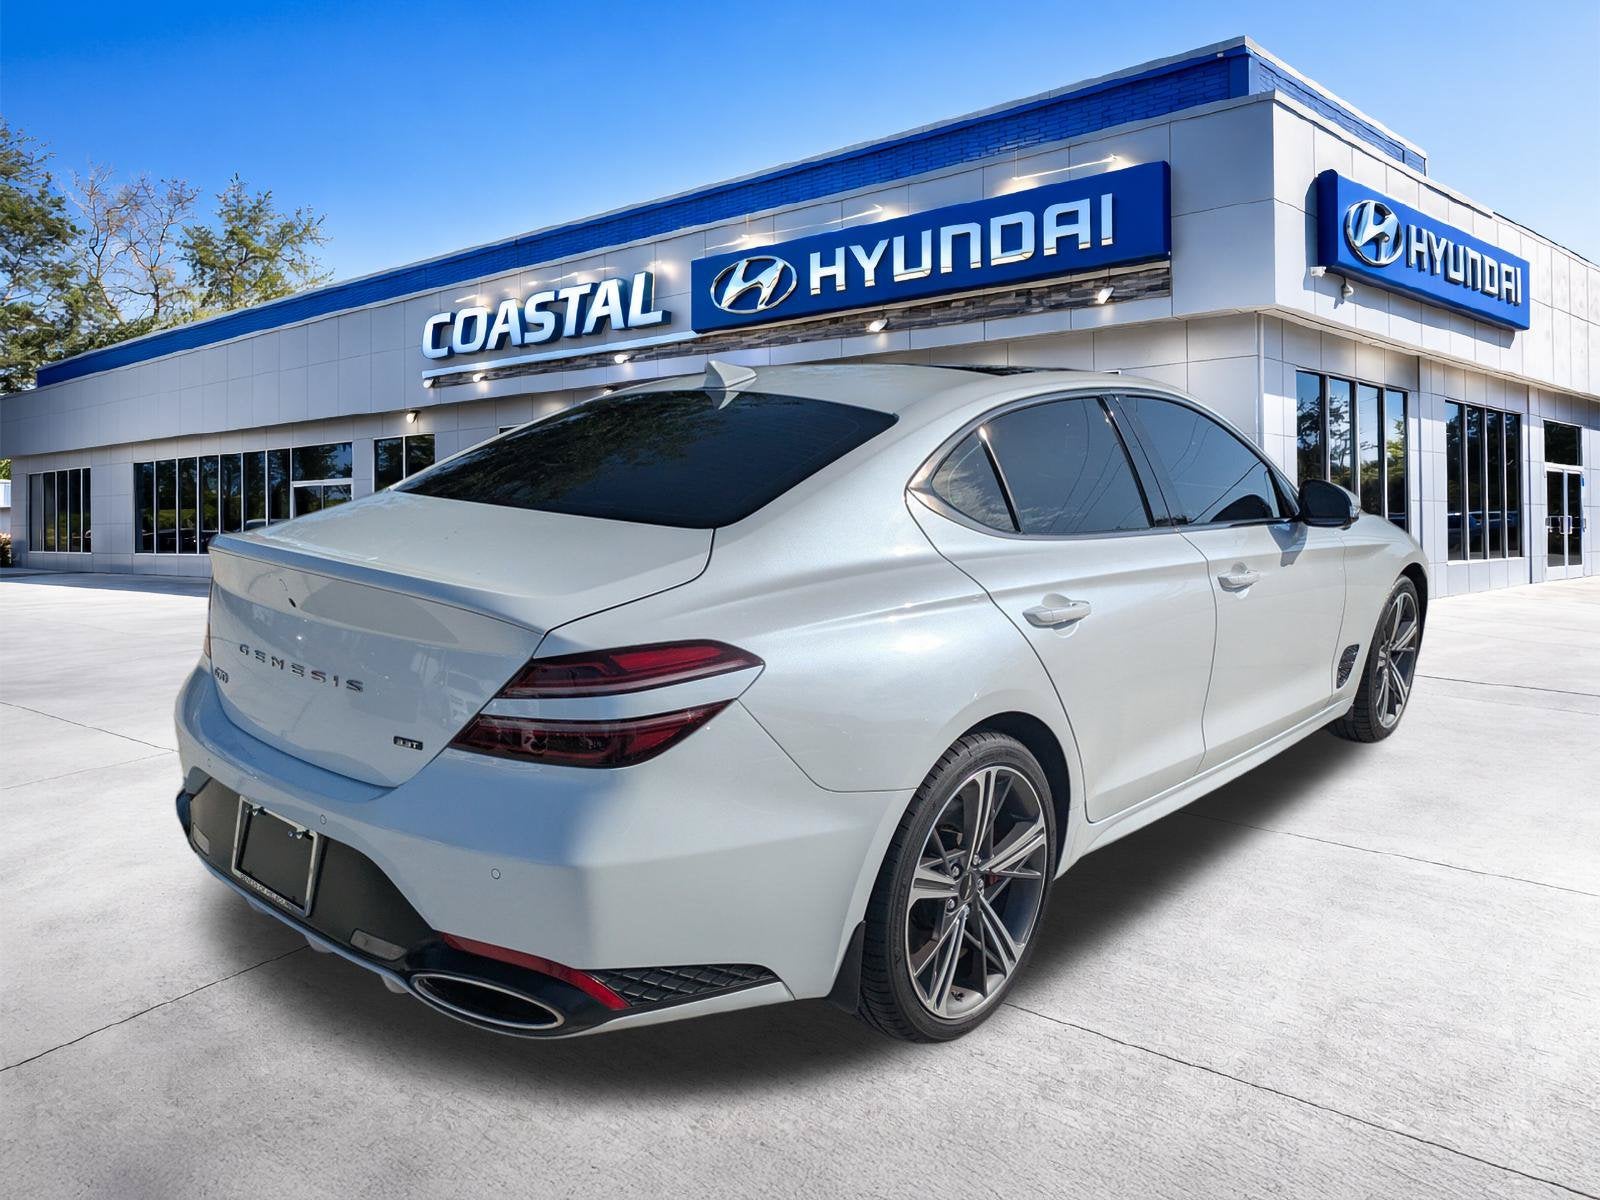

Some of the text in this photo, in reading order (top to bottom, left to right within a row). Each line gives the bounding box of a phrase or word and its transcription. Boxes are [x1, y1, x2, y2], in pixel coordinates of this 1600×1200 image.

[809, 193, 1114, 295] HYUNDAI
[1406, 224, 1522, 306] HYUNDAI
[422, 271, 669, 359] COASTAL
[239, 643, 364, 692] GENESIS
